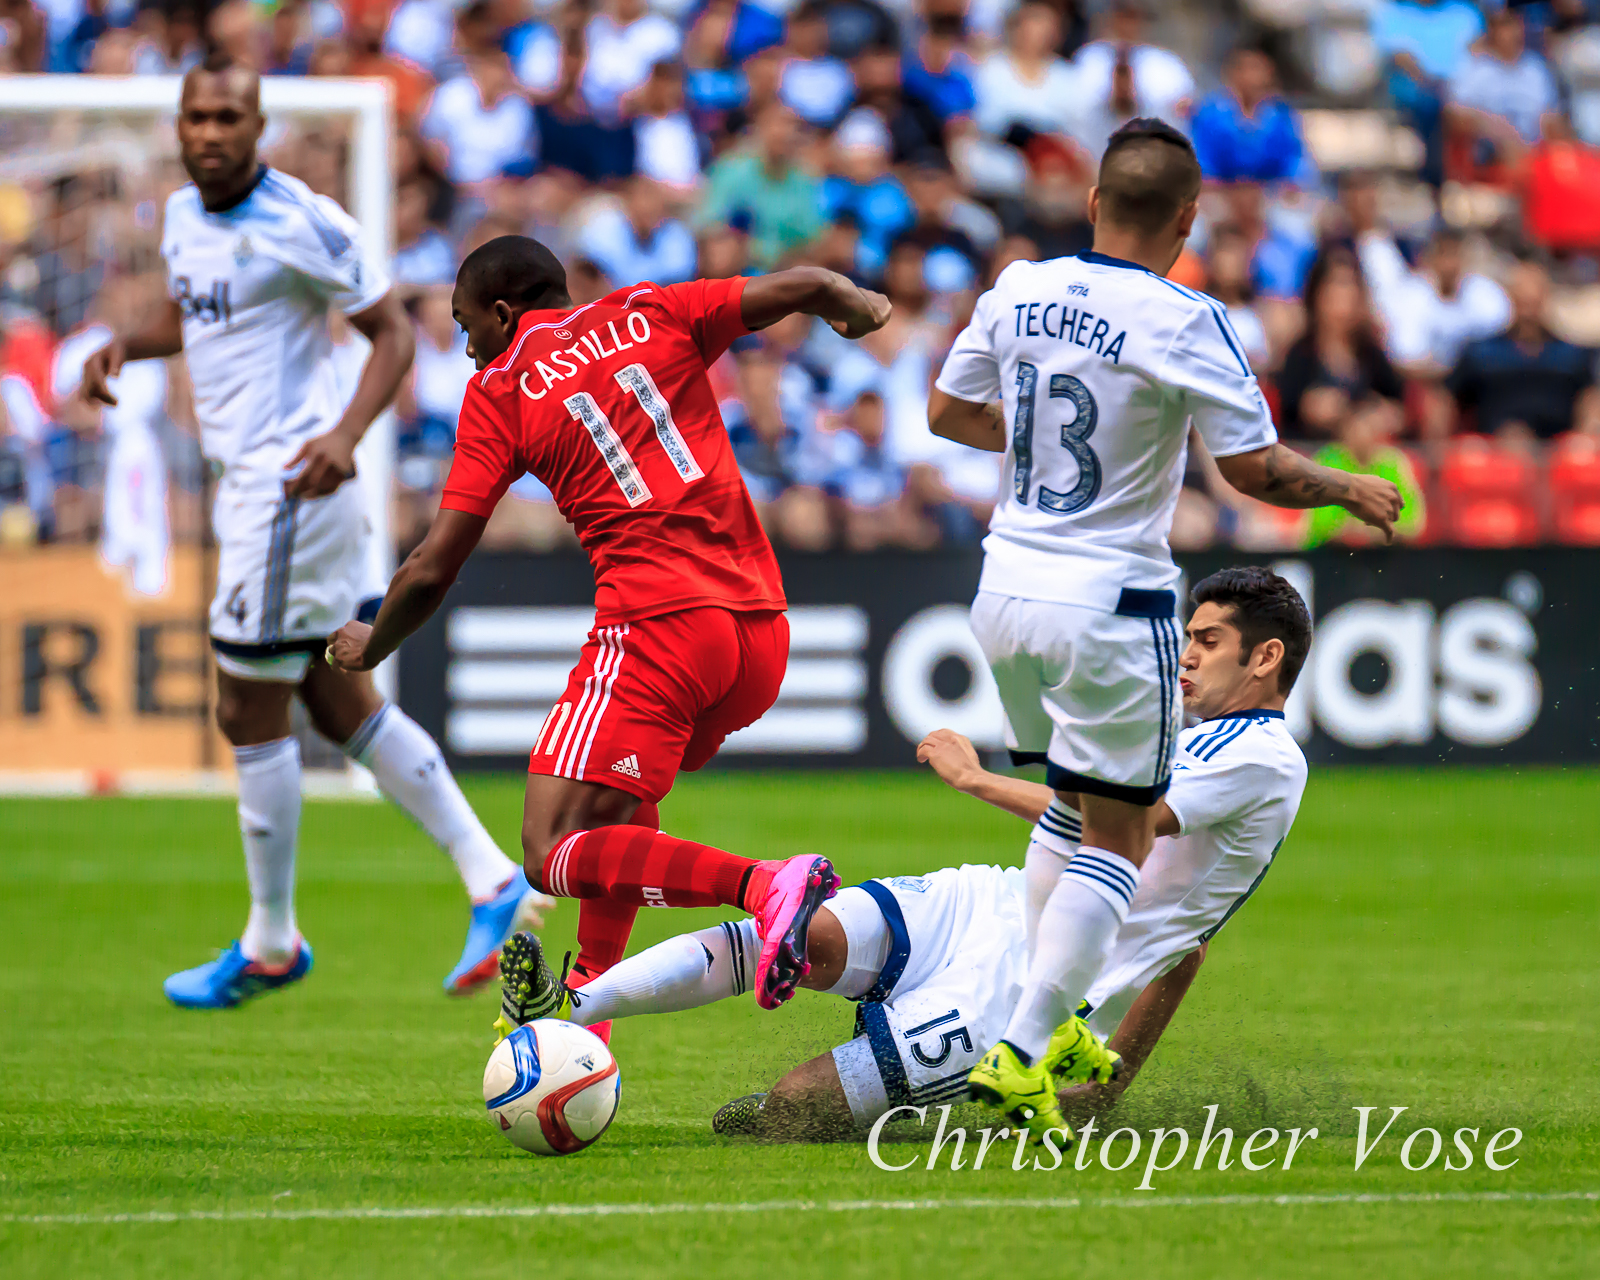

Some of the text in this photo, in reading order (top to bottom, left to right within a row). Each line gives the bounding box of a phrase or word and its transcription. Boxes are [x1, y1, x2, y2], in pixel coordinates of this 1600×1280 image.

[1066, 284, 1090, 298] 1974
[519, 311, 651, 401] CASTILLO
[1014, 303, 1127, 364] TECHERA
[563, 363, 705, 509] 11
[1013, 361, 1103, 515] 13
[611, 764, 642, 779] adidas
[903, 1008, 974, 1068] 15
